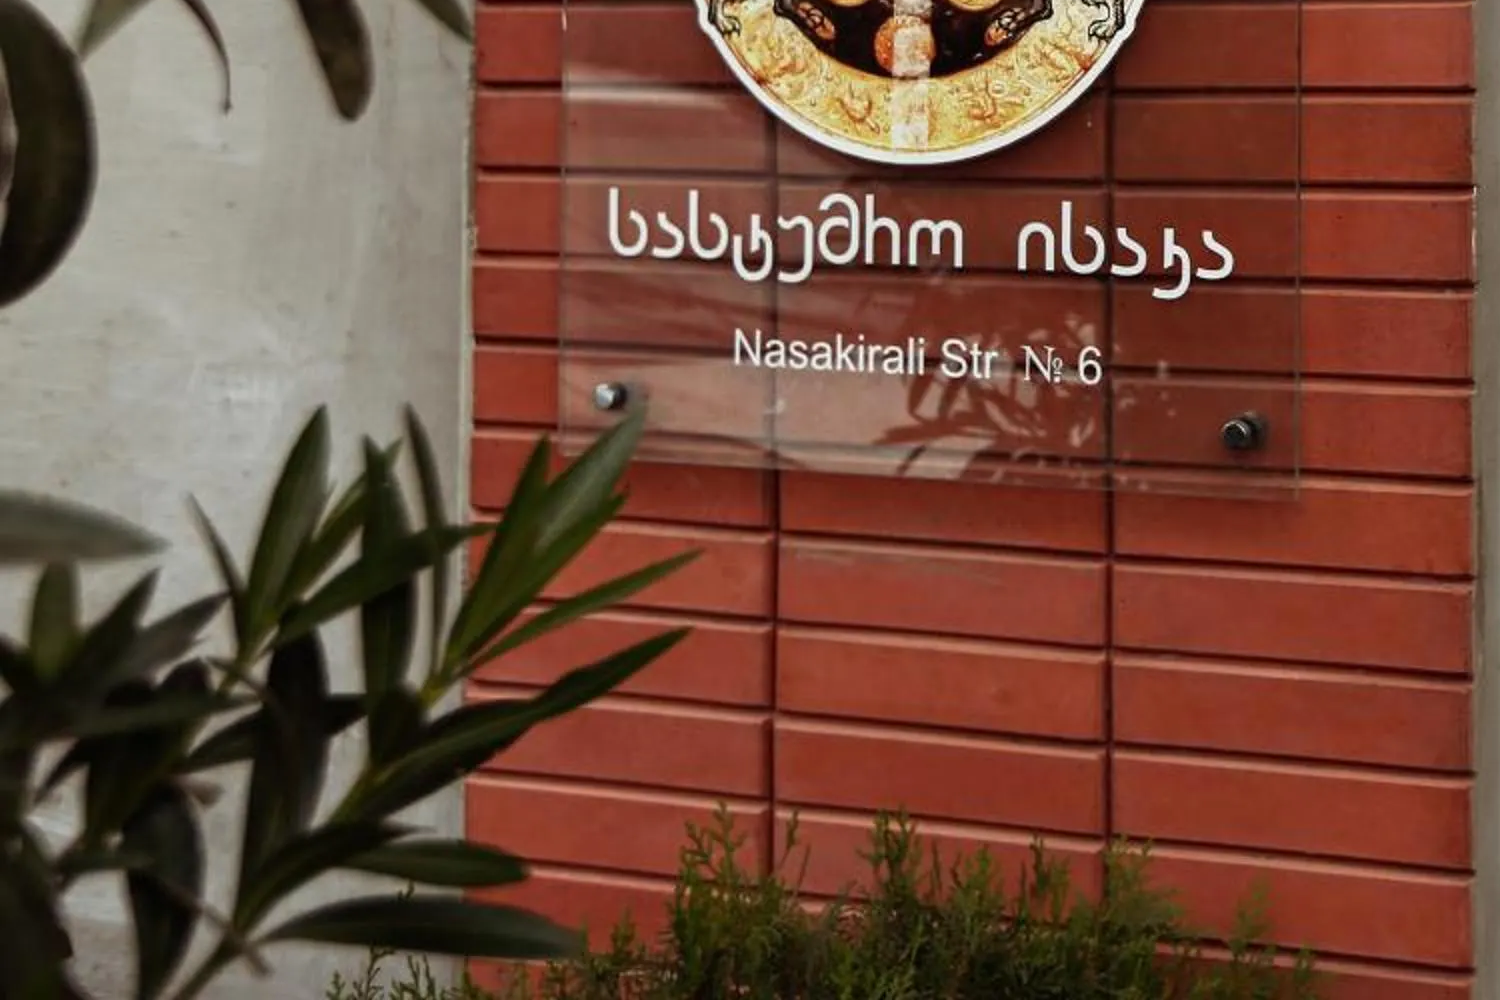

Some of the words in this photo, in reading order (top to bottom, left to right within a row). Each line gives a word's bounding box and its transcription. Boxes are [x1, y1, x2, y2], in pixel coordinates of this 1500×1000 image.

[607, 186, 964, 284] სასტუმრო
[1016, 200, 1235, 300] ისაკა
[733, 328, 925, 377] Nasakirali
[939, 337, 1000, 380] Str
[1020, 344, 1064, 384] №
[1078, 345, 1102, 386] 6
